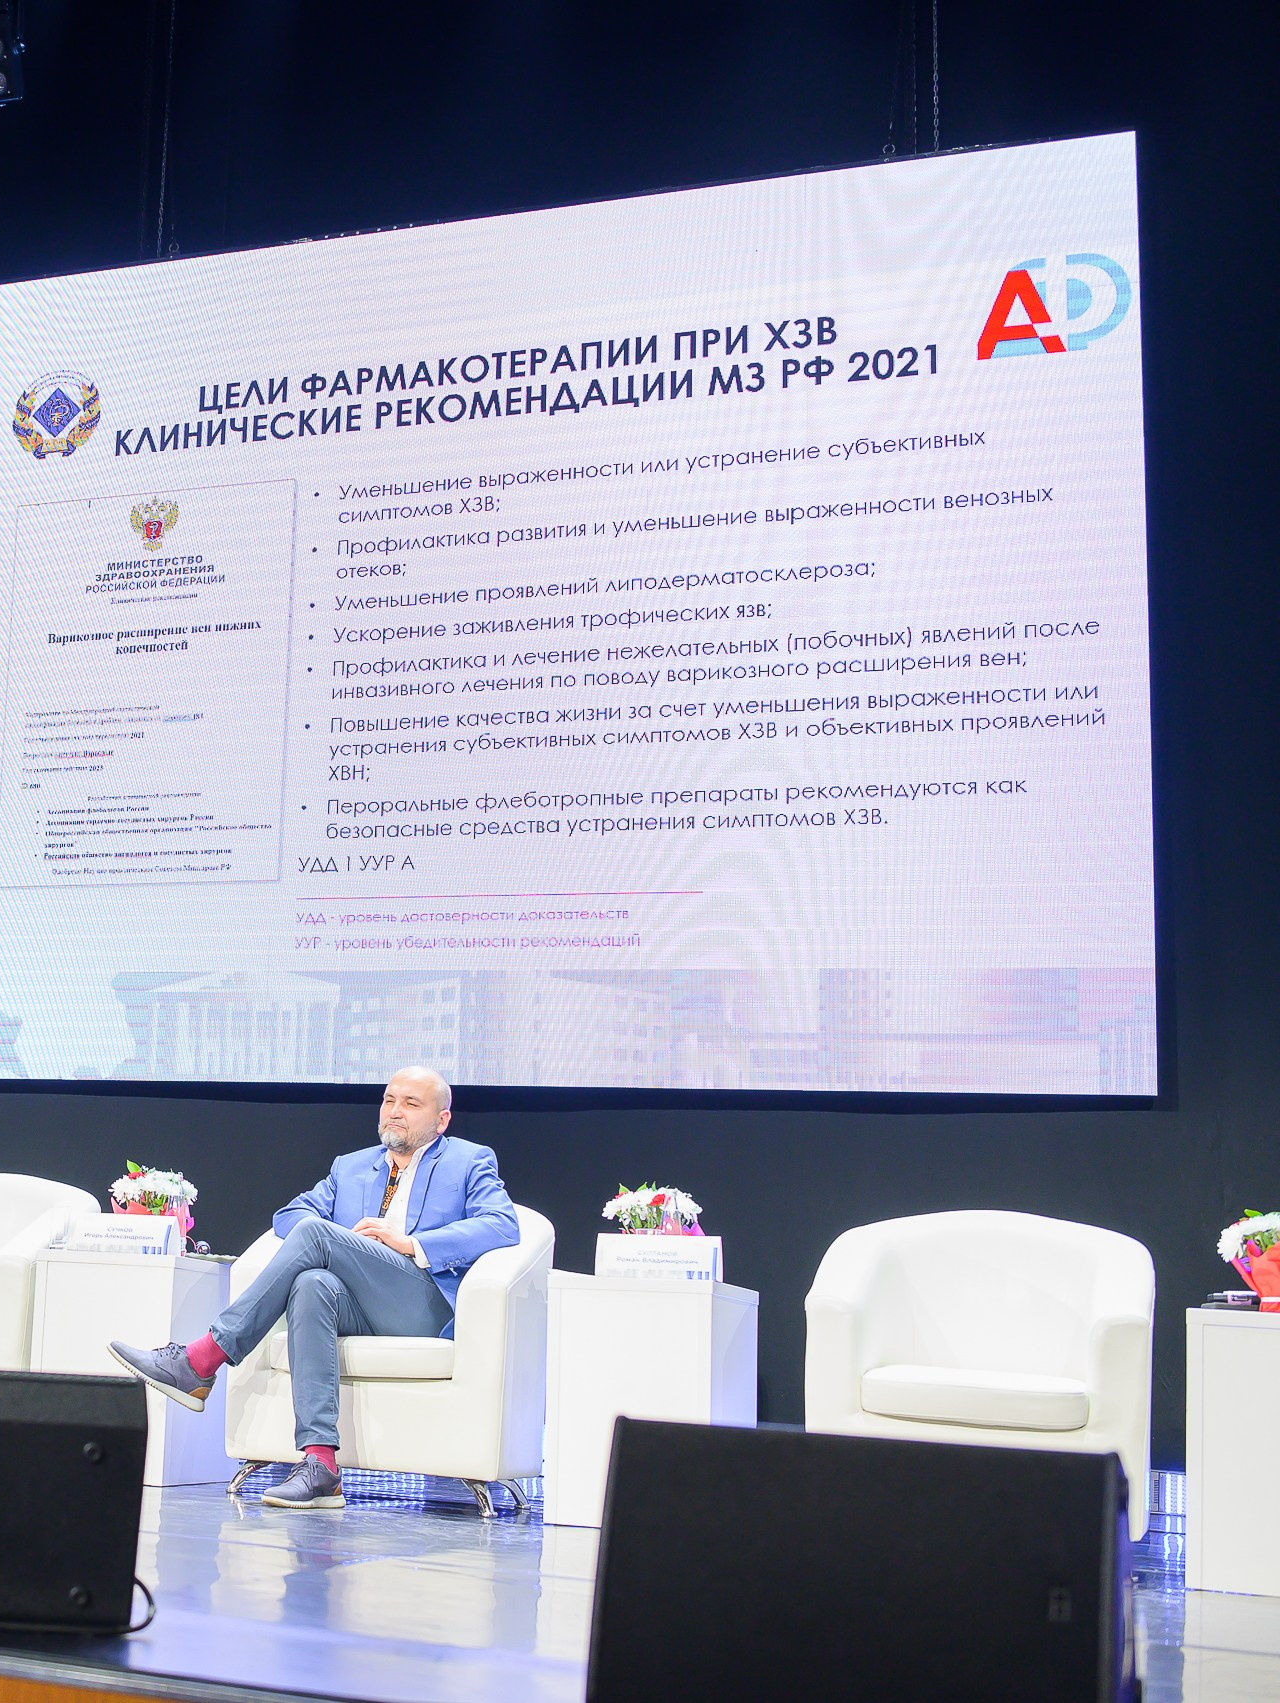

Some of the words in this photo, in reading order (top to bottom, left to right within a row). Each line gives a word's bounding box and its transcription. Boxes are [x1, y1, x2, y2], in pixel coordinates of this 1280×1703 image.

[198, 375, 289, 414] ЦЕЛИ
[300, 334, 658, 401] ФАРМАКОТЕРАПИИ
[673, 324, 749, 362] ПРИ
[114, 403, 362, 458] КЛИНИЧЕСКИЕ
[374, 368, 694, 430] РЕКОМЕНДАЦИИ
[707, 361, 766, 397] МЗ
[781, 355, 835, 390] РФ
[847, 343, 938, 383] 2021
[338, 476, 473, 501] Уменьшение
[478, 462, 634, 491] выраженности
[641, 458, 679, 474] или
[685, 445, 821, 475] устранение
[827, 431, 986, 461] субъективных
[337, 502, 454, 525] симптомов
[337, 530, 491, 560] Профилактика
[496, 523, 587, 548] развития
[593, 522, 606, 536] и
[612, 509, 758, 539] уменьшение
[765, 497, 936, 526] выраженности
[943, 487, 1054, 510] венозных
[94, 564, 215, 583] ЗДРАВООХРАНЕНИЯ
[106, 554, 204, 572] МИНИСТЕРСТВО
[336, 563, 407, 580] отеков;
[84, 579, 158, 595] РОССИЙСКОЙ
[159, 573, 226, 589] ФЕДЕРАЦИИ
[334, 590, 470, 612] Уменьшение
[475, 577, 599, 605] проявлений
[604, 562, 876, 593] липодерматосклероза;
[47, 632, 115, 647] Варикозное
[116, 626, 189, 642] расширение
[190, 624, 212, 634] вен
[214, 621, 262, 633] нижних
[333, 623, 447, 645] Ускорение
[453, 615, 575, 637] заживления
[580, 605, 731, 633] трофических
[736, 602, 772, 619] язв;
[115, 639, 189, 656] конечностей
[332, 654, 487, 680] Профилактика
[493, 654, 506, 667] и
[510, 648, 601, 667] лечение
[606, 638, 779, 661] нежелательных
[786, 626, 913, 655] (побочных)
[921, 621, 1016, 645] явлений
[1024, 620, 1101, 639] после
[331, 681, 456, 700] инвазивного
[461, 675, 544, 693] лечения
[550, 674, 577, 689] по
[583, 669, 661, 688] поводу
[667, 662, 810, 687] варикозного
[816, 653, 972, 680] расширения
[979, 651, 1027, 668] вен;
[330, 714, 450, 734] Повышение
[456, 710, 550, 728] качества
[554, 706, 622, 723] жизни
[627, 705, 652, 720] за
[658, 702, 707, 719] счет
[712, 695, 860, 720] уменьшения
[867, 687, 1047, 712] выраженности
[1054, 685, 1099, 701] или
[328, 739, 447, 761] устранения
[452, 732, 597, 755] субъективных
[602, 727, 732, 746] симптомов
[785, 725, 799, 738] и
[805, 717, 955, 737] объективных
[961, 707, 1106, 735] проявлений
[328, 764, 371, 783] ХВН;
[327, 797, 469, 818] Пероральные
[475, 790, 644, 814] флеботропные
[651, 787, 779, 809] препараты
[785, 781, 978, 805] рекомендуются
[986, 780, 1028, 795] как
[325, 822, 453, 840] безопасные
[458, 819, 561, 840] средства
[566, 815, 696, 838] устранения
[702, 811, 836, 830] симптомов
[298, 856, 339, 874] УДД
[359, 854, 396, 872] УУР
[400, 854, 415, 871] А
[295, 912, 328, 927] УДД
[338, 913, 398, 927] уровень
[400, 911, 515, 926] достоверности
[518, 909, 630, 922] доказательств
[294, 935, 322, 950] УУР
[334, 938, 393, 952] уровень
[396, 935, 516, 952] убедительности
[519, 932, 641, 950] рекомендаций
